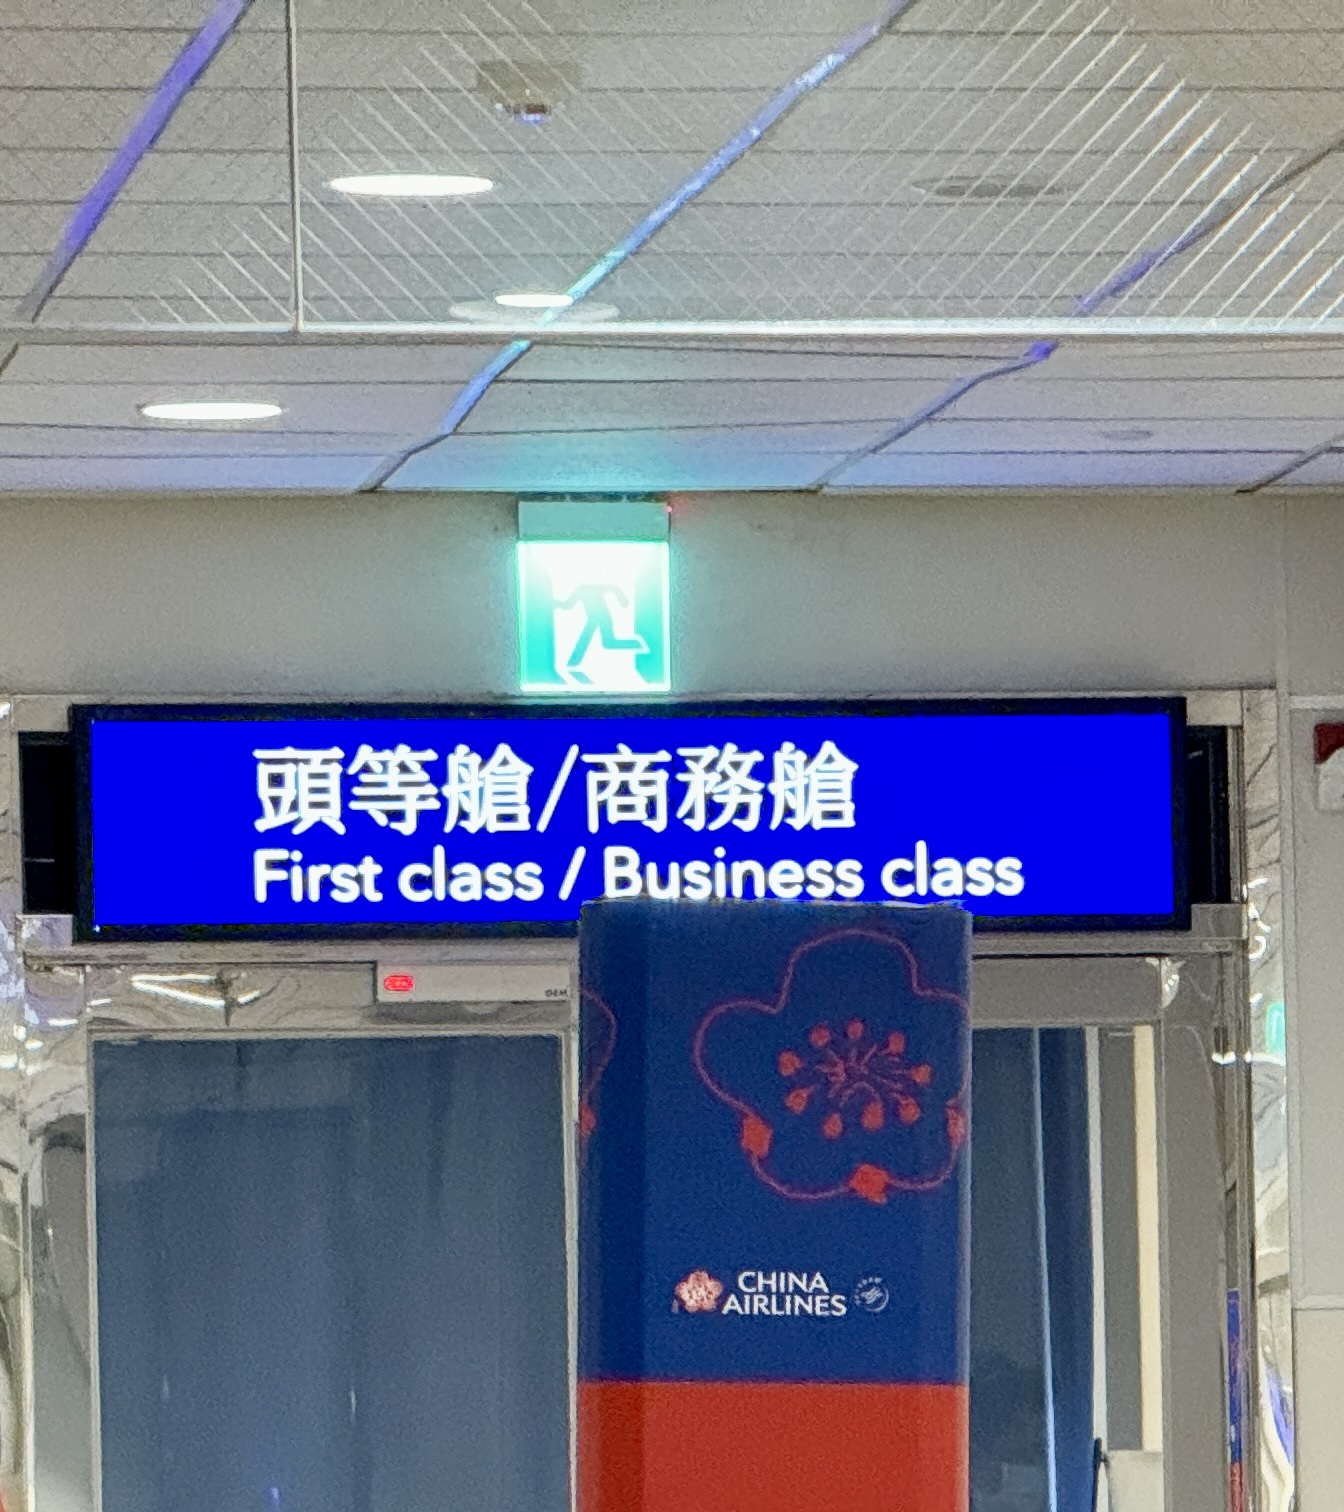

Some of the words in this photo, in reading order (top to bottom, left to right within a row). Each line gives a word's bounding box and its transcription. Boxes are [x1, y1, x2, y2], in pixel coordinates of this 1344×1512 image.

[252, 741, 859, 836] 頭等艙/商務艙
[253, 848, 384, 904] First
[398, 844, 545, 903] class
[603, 845, 865, 900] Business
[880, 839, 1025, 897] class
[737, 1270, 830, 1294] CHINA
[721, 1293, 847, 1317] AIRLINES
